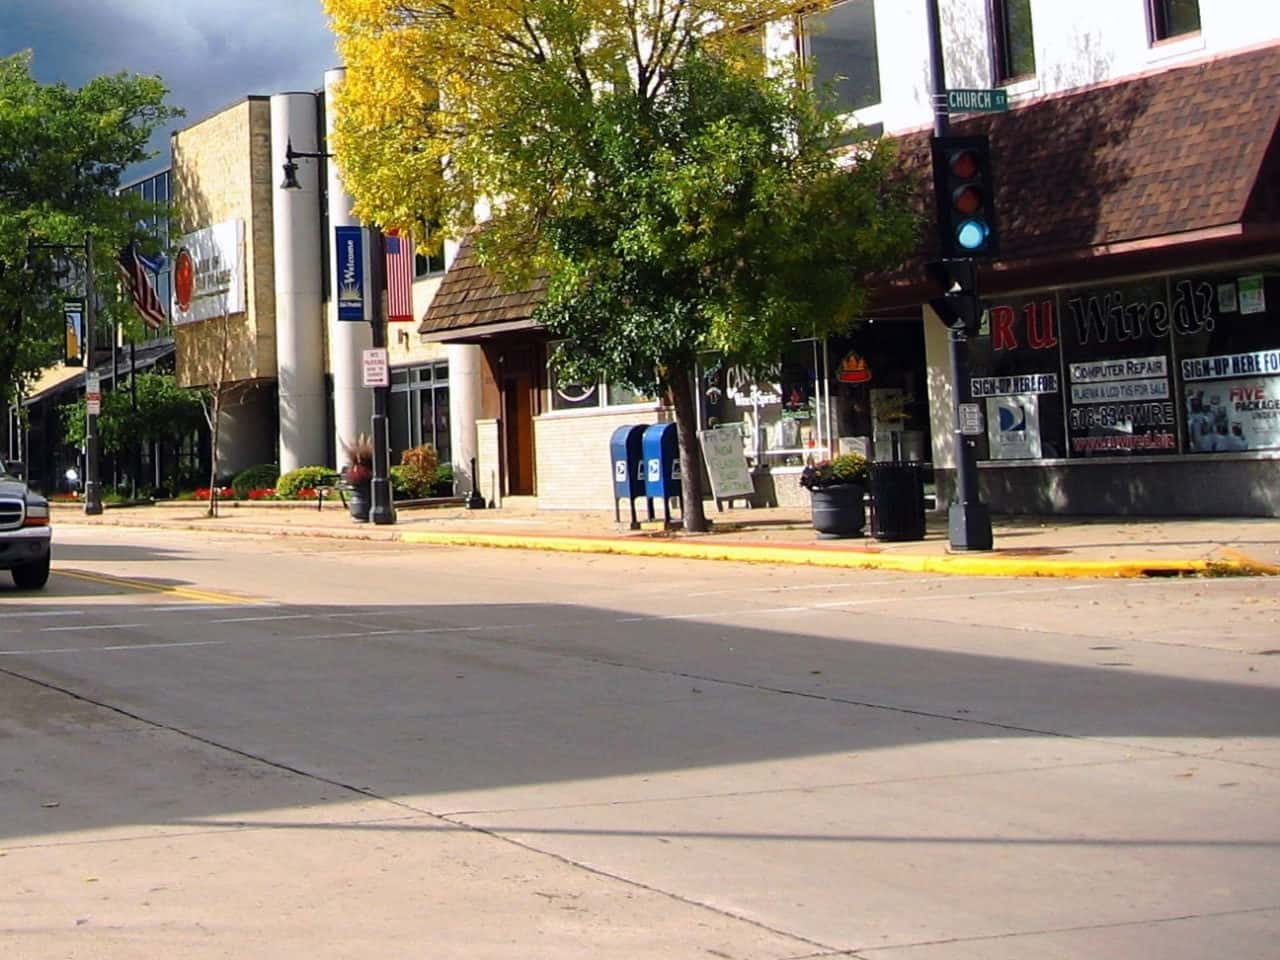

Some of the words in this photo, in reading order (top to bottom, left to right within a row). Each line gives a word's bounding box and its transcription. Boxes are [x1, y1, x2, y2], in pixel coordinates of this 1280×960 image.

[949, 91, 992, 109] CHURCH
[343, 239, 355, 284] Welcome
[990, 305, 1017, 351] R
[1023, 300, 1057, 350] U
[1074, 364, 1126, 380] COMPUTER
[1126, 360, 1163, 375] REPAIR
[1183, 358, 1229, 378] SIGN-UP
[1232, 355, 1261, 374] HERE
[1263, 351, 1280, 371] FO
[972, 378, 1012, 395] SIGN-UP
[1230, 385, 1264, 403] FIVE
